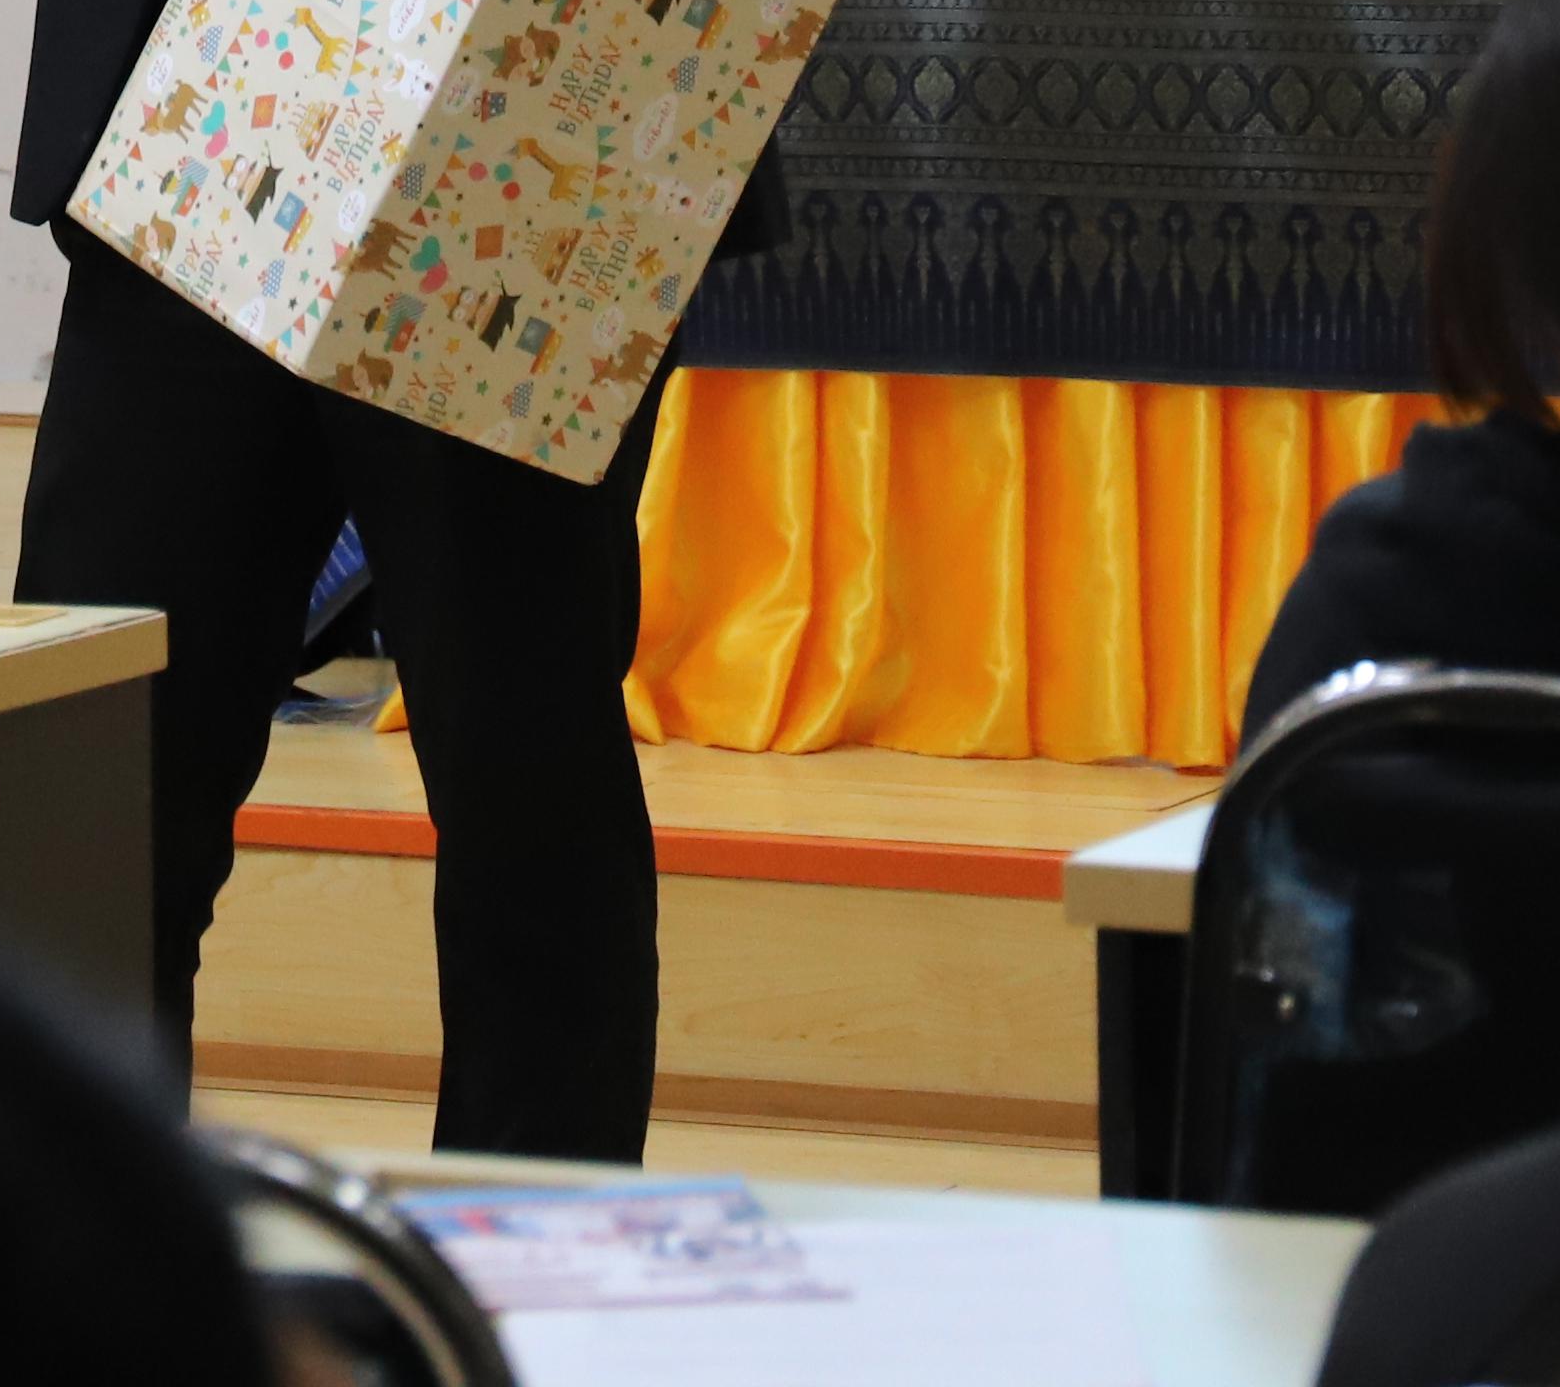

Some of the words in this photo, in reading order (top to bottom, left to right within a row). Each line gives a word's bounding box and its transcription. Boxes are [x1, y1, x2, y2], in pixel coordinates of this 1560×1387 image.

[548, 43, 594, 112] HAPPY
[556, 33, 623, 137] BIRTHDAY
[323, 98, 362, 169] HAPPY
[326, 89, 386, 194] BIRTHDAY
[174, 238, 201, 294] APPY
[568, 220, 611, 290] HAPPY
[575, 209, 641, 314] BIRTHDAY
